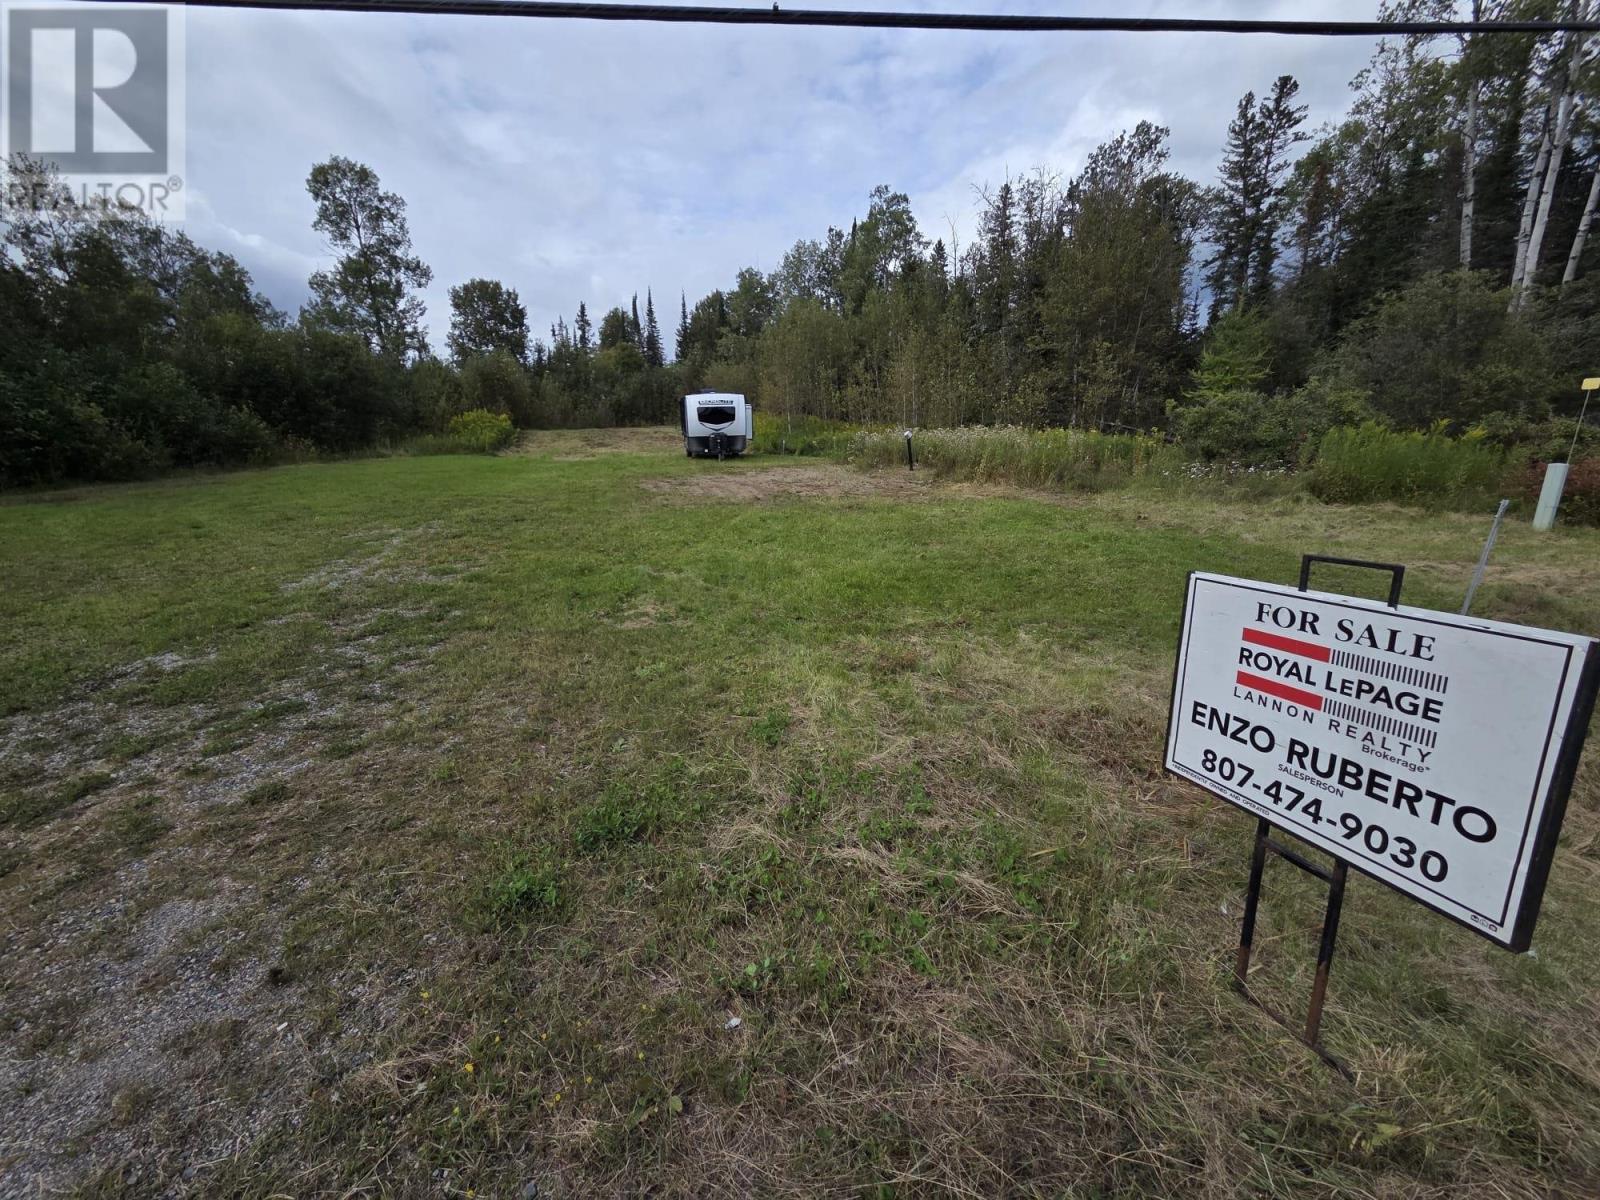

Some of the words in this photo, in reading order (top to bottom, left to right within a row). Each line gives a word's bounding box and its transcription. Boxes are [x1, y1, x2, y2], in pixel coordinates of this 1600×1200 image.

[1255, 602, 1321, 636] FOR
[1335, 618, 1437, 662] SALE
[1238, 647, 1316, 686] ROYAL
[1234, 686, 1314, 724] LANNON
[1328, 721, 1432, 763] REALTY
[1191, 701, 1275, 753] ENZO
[1286, 738, 1497, 843] RUBERTO
[1278, 763, 1344, 798] SALESPERSON
[1201, 749, 1449, 883] 807-474-9030
